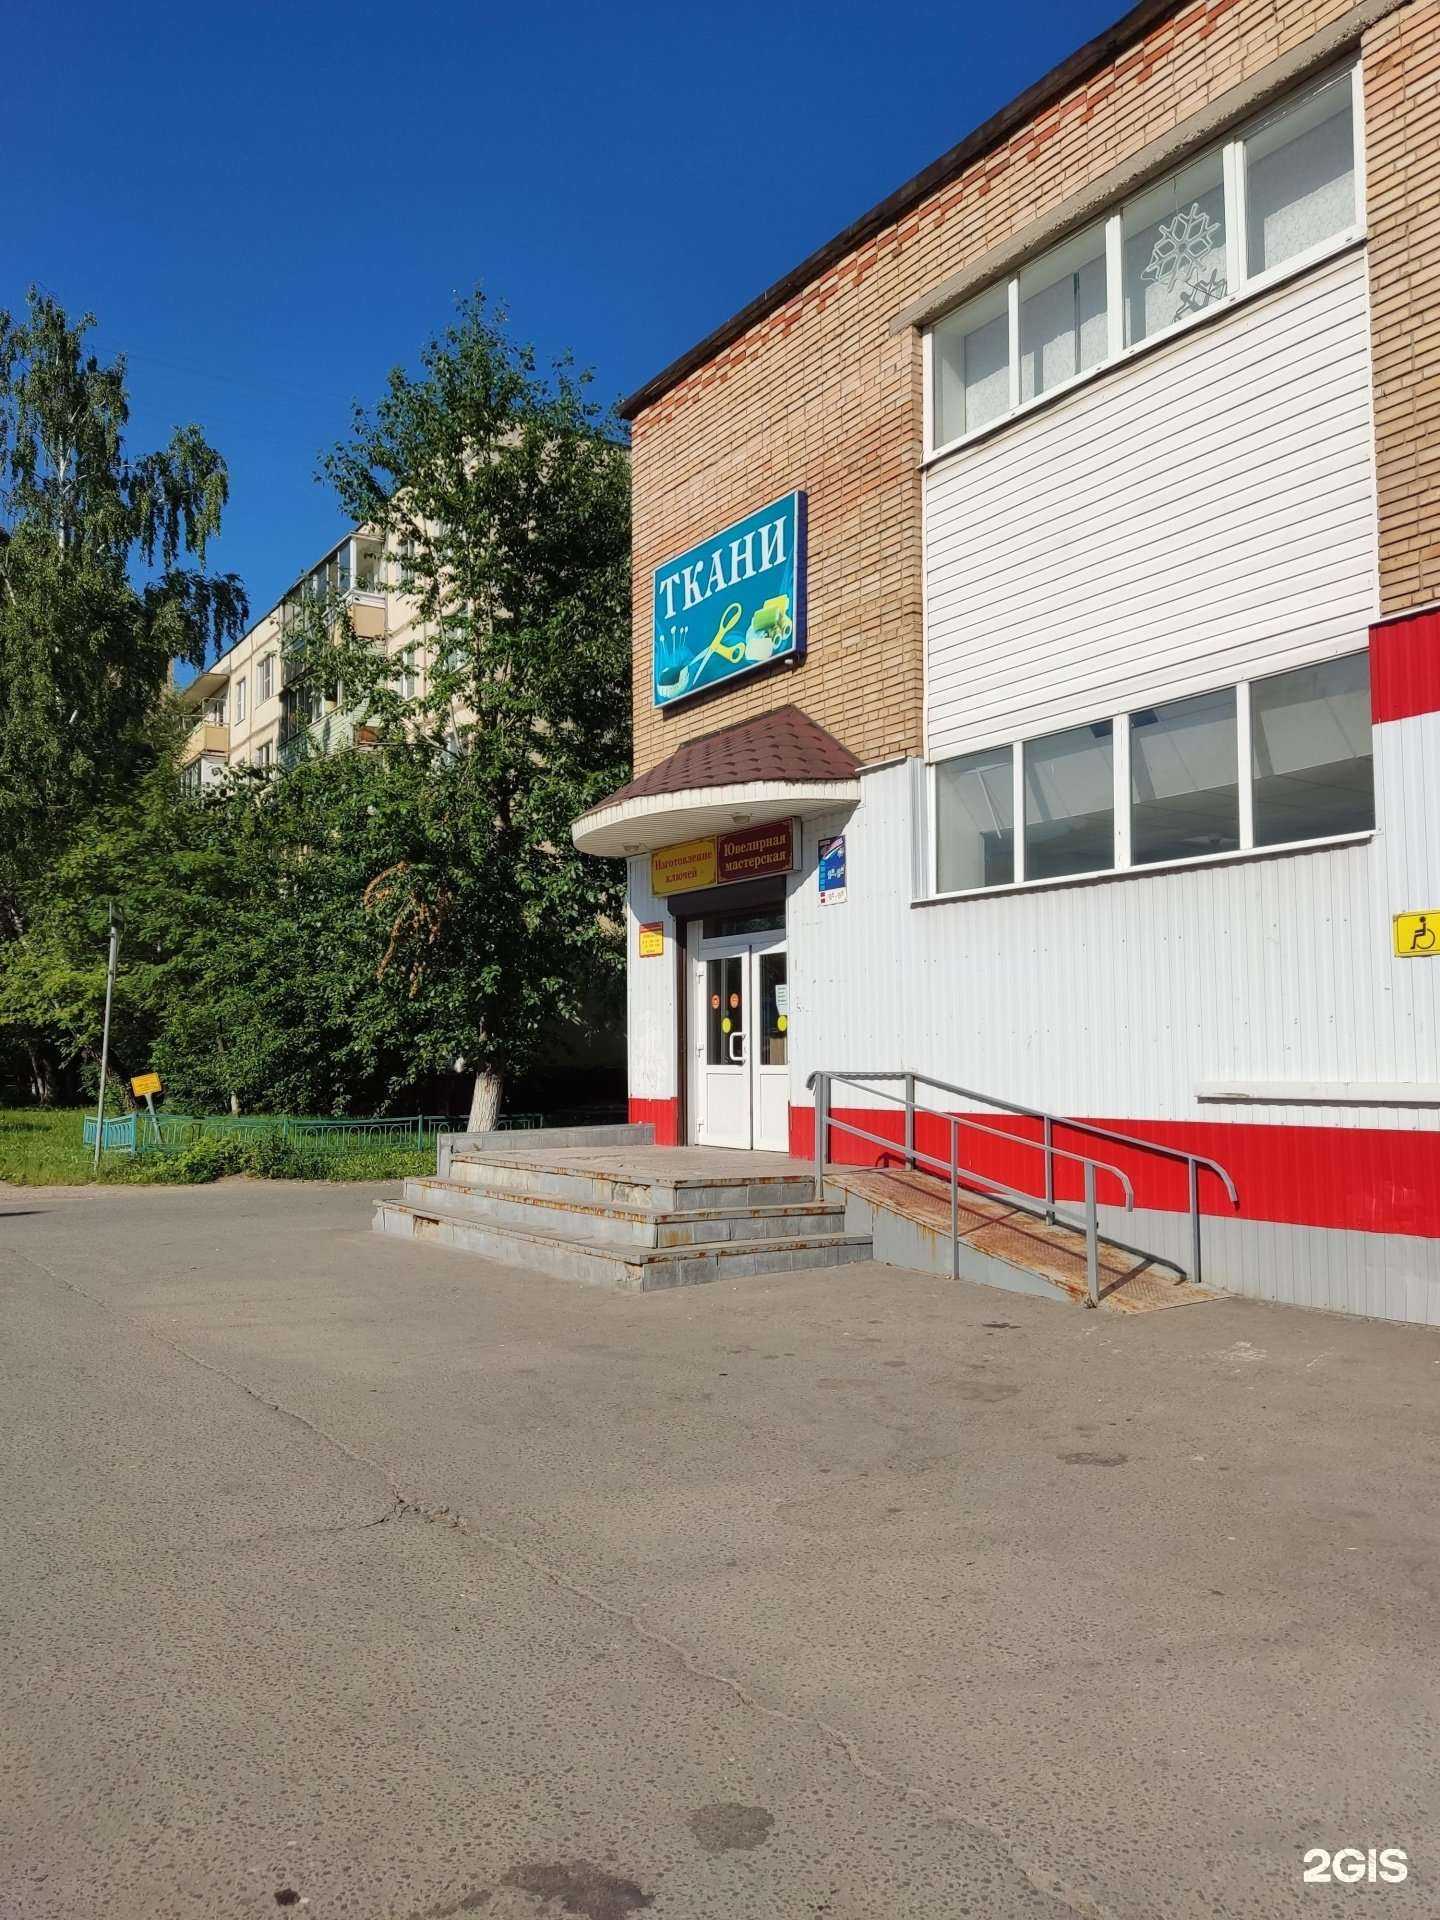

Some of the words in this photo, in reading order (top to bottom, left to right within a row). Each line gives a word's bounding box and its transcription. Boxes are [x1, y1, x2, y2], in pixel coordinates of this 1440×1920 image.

[659, 515, 788, 619] ТКАНИ
[724, 833, 786, 857] Ювелирная
[655, 850, 712, 871] Изготовление
[724, 850, 786, 872] мастерская
[665, 867, 697, 883] ключей
